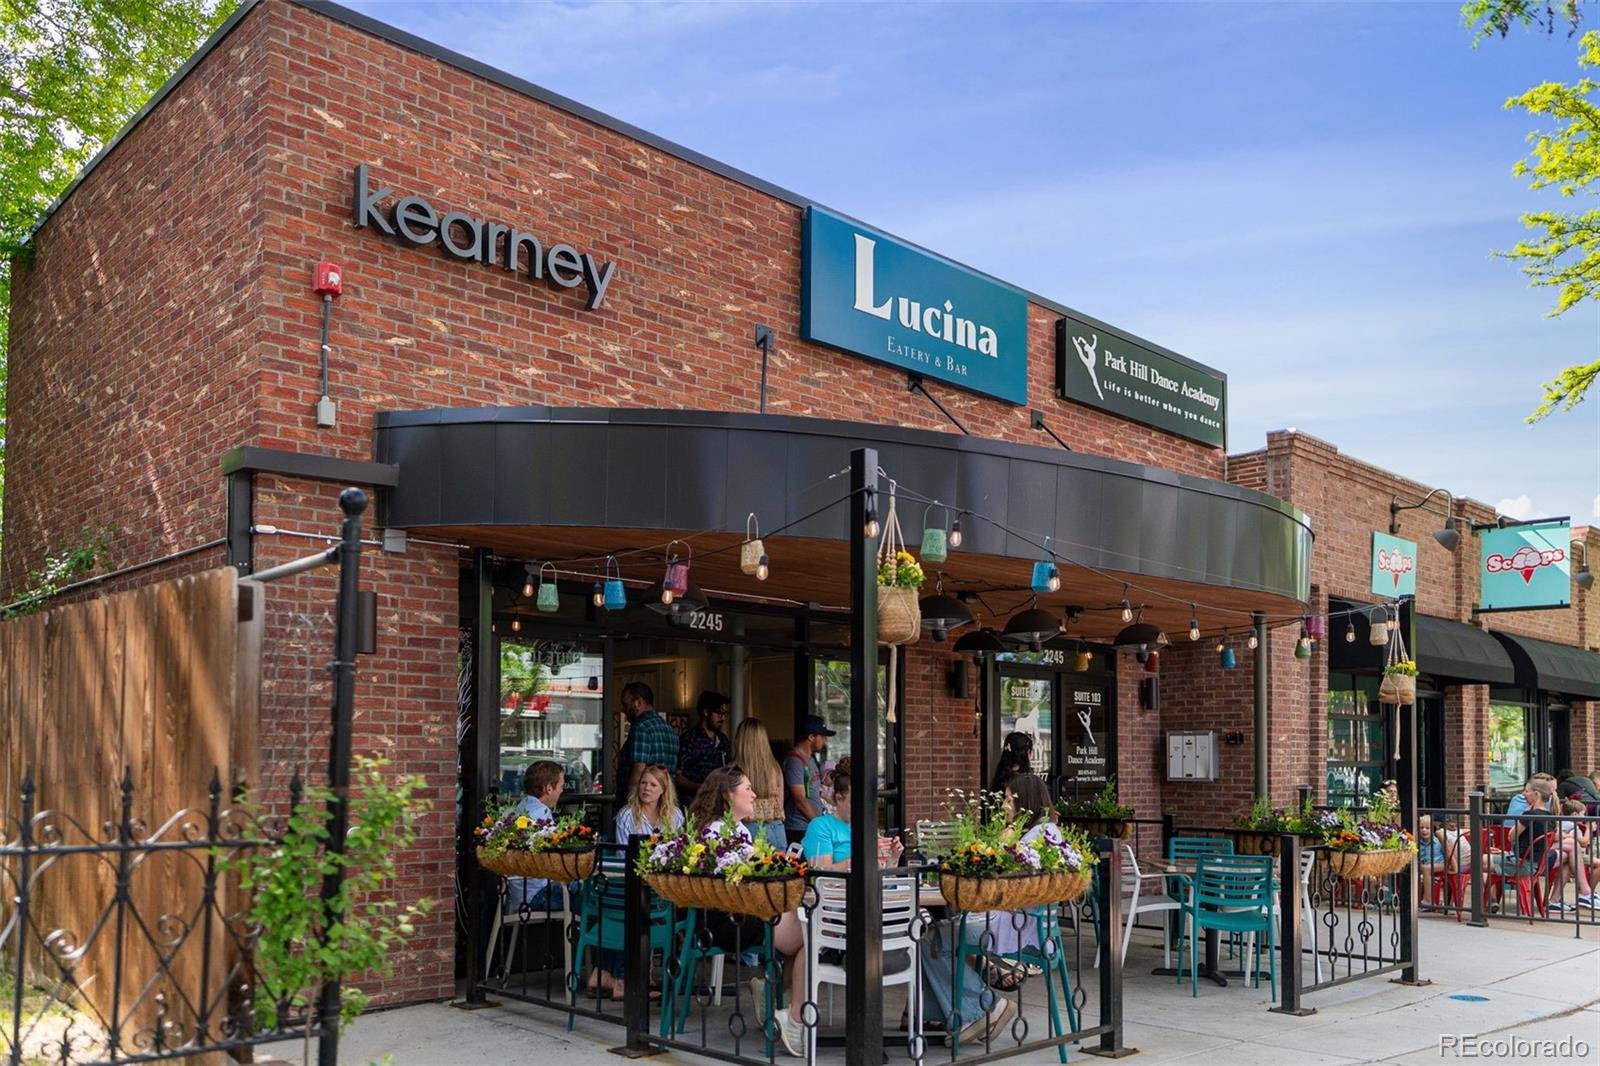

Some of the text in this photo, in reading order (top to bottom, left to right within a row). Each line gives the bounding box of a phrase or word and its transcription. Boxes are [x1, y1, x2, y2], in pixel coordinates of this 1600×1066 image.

[354, 163, 616, 311] kearney
[853, 233, 998, 358] Lucina
[887, 336, 968, 376] EATERY & BAR
[1104, 350, 1220, 411] Park Hill Dance Academy
[1103, 380, 1220, 429] Life is better when you dance
[1378, 547, 1412, 573] Scoops
[1487, 547, 1565, 573] Scoops
[690, 611, 723, 631] 2245
[1044, 649, 1064, 665] 2245
[1011, 686, 1029, 698] SUITE
[1074, 691, 1091, 702] SUITE
[1067, 755, 1083, 764] Dance
